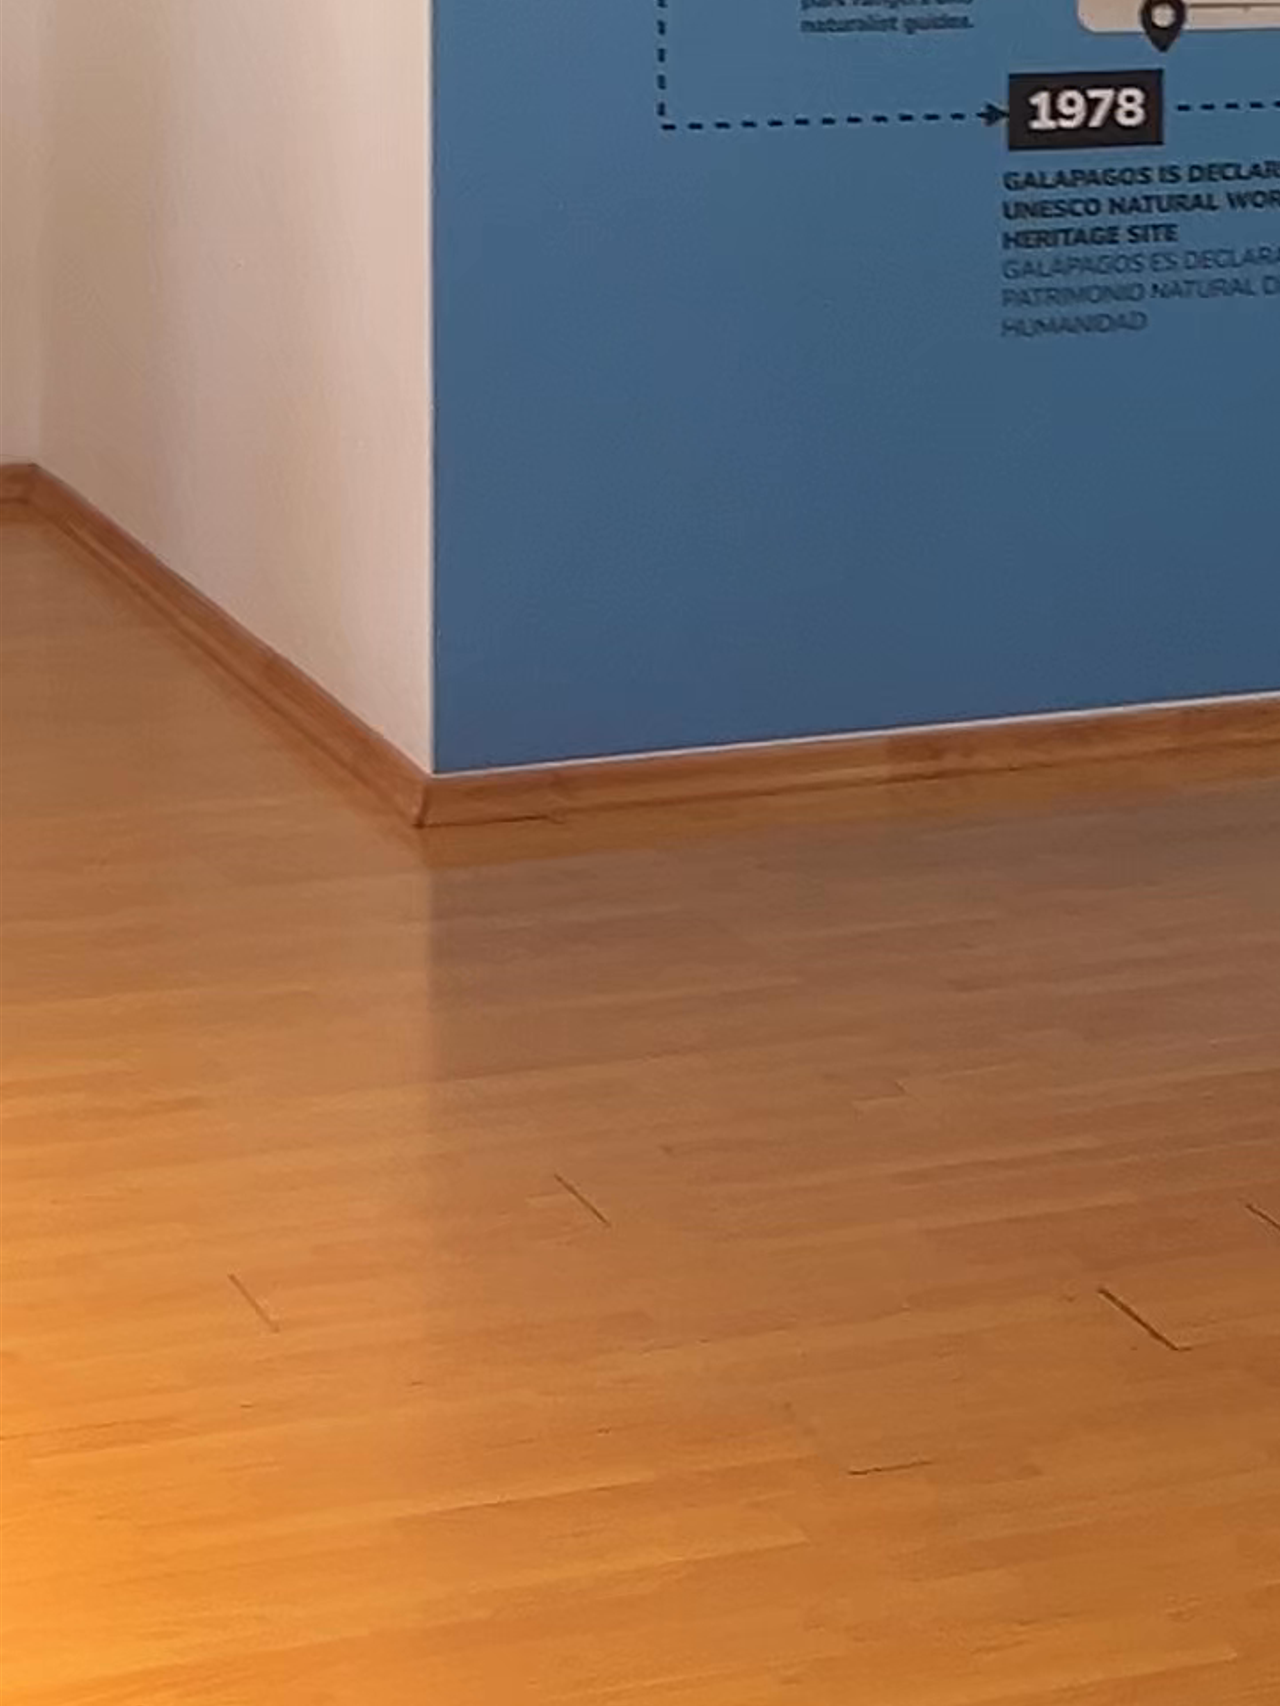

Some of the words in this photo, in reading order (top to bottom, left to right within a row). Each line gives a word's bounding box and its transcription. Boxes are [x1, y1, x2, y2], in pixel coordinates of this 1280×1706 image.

[1031, 90, 1144, 129] 1978
[1004, 166, 1152, 191] GALAPAGOS
[1159, 165, 1181, 184] IS
[1003, 197, 1101, 219] UNESCO
[1109, 193, 1218, 215] NATURAL
[1003, 226, 1119, 249] HERITAGE
[1127, 224, 1177, 244] SITE
